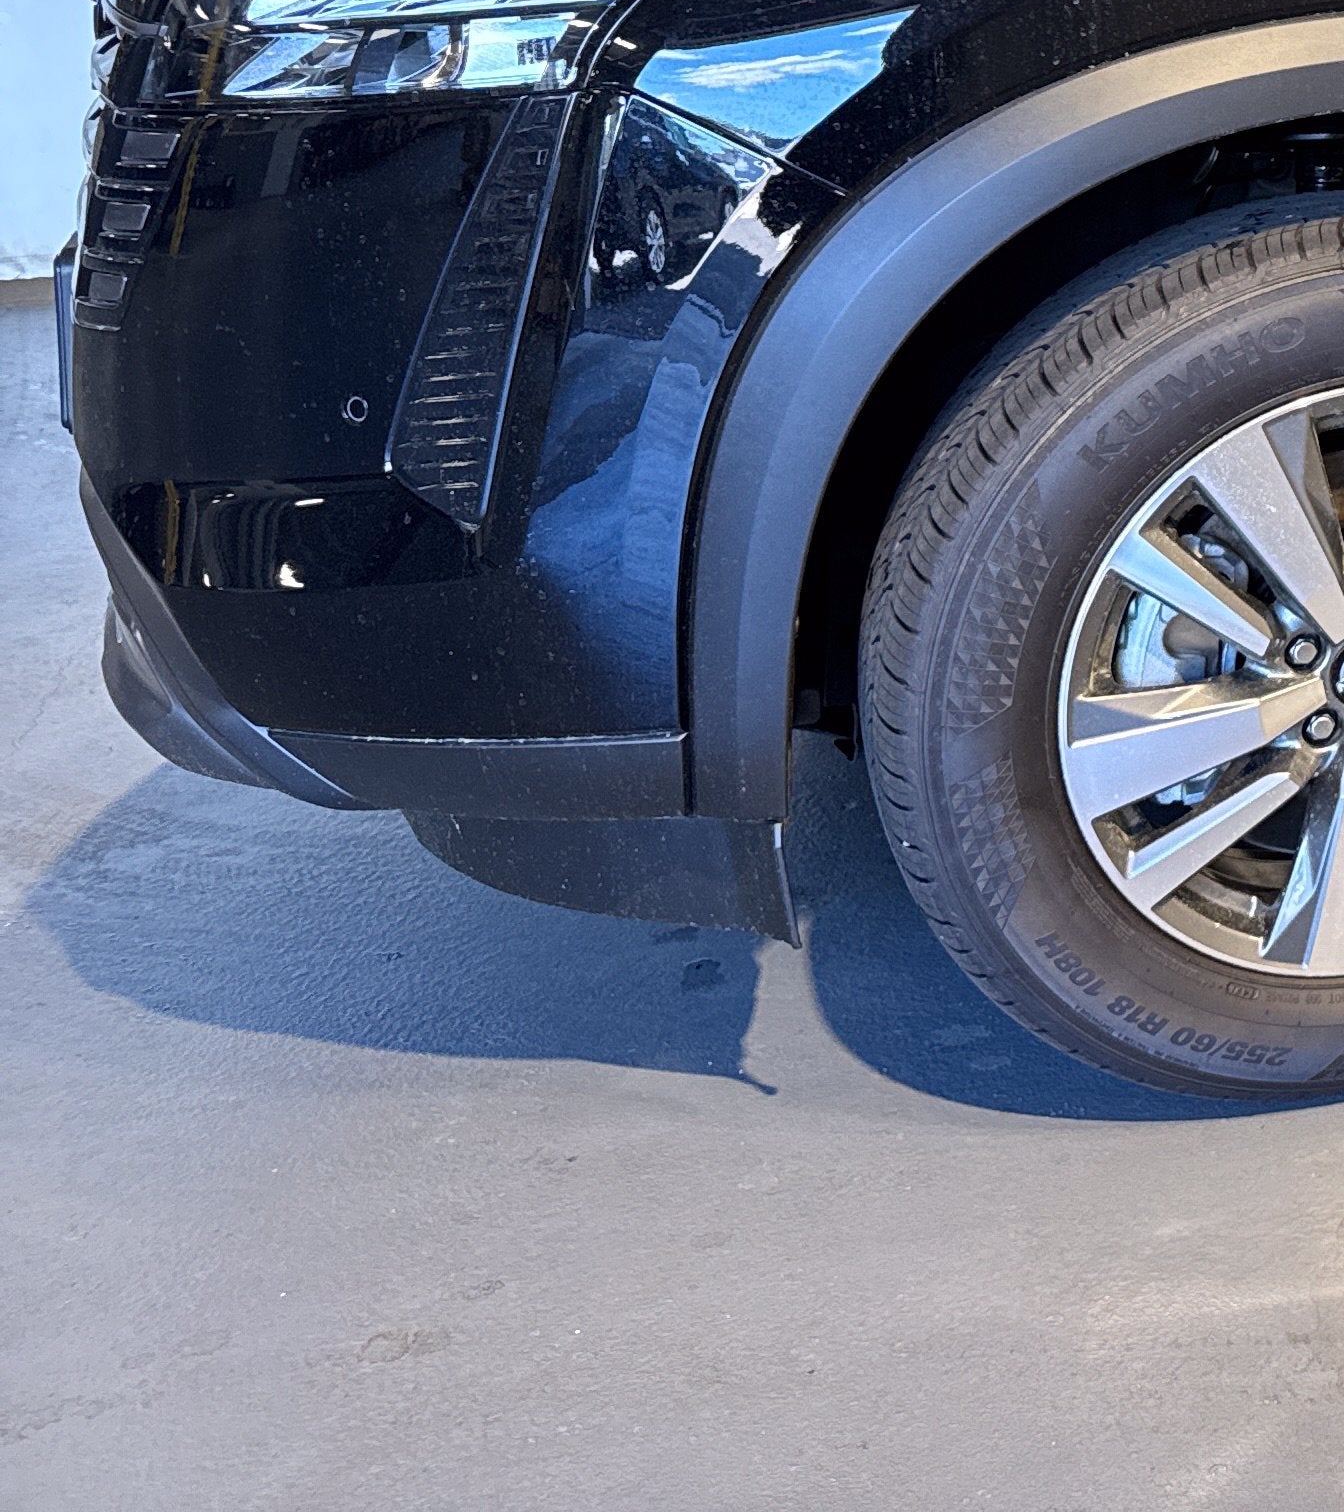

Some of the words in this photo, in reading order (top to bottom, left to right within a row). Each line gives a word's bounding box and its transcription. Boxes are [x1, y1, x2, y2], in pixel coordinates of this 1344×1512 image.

[1076, 316, 1306, 474] KUMHO
[1034, 932, 1109, 997] 108H
[1105, 994, 1172, 1037] R18
[1169, 1025, 1293, 1067] 255/60
